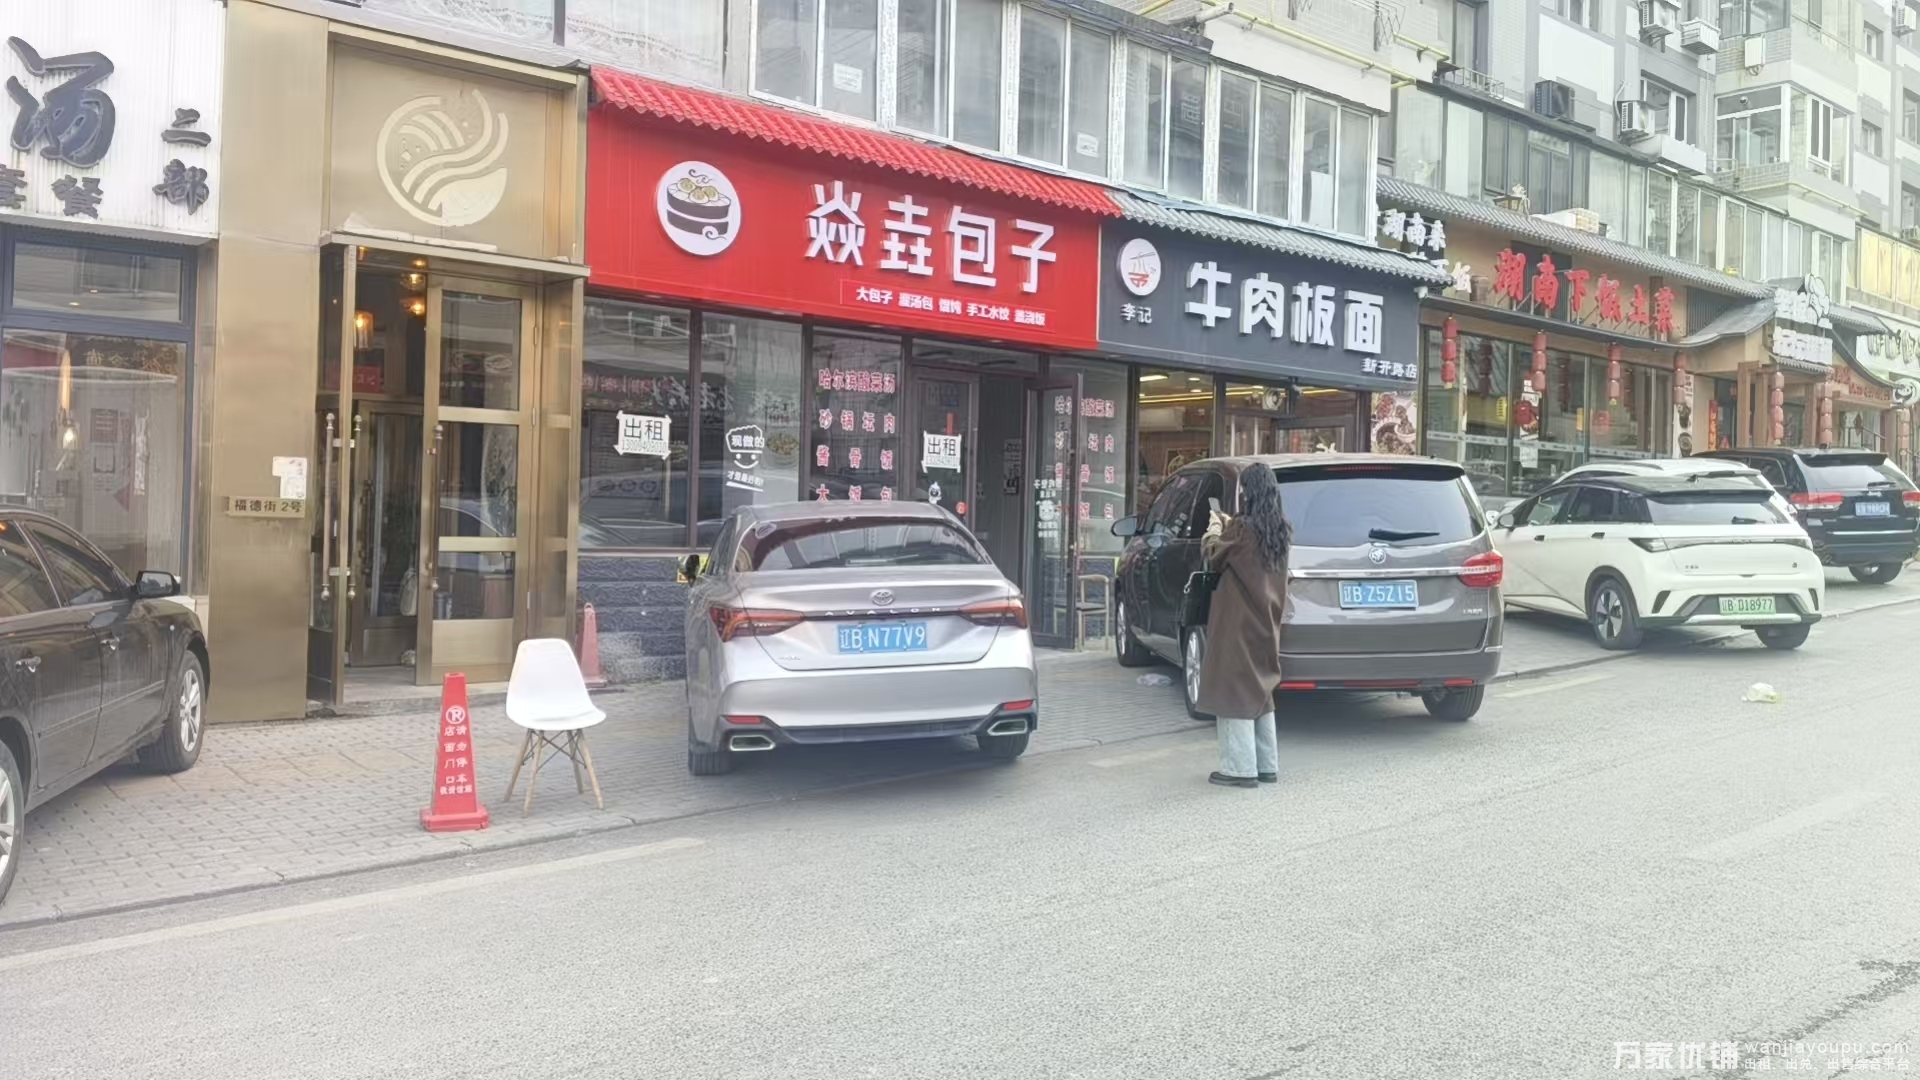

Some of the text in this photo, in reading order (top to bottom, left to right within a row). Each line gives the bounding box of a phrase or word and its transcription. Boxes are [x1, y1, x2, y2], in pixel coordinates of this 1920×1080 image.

[152, 108, 211, 215] 二部
[804, 180, 1057, 294] 焱垚包子
[856, 286, 893, 305] 大包子
[967, 302, 1010, 321] 手工水饺
[1120, 302, 1153, 324] 李记
[1184, 261, 1384, 354] 牛肉板面
[1361, 357, 1418, 379] 新开路店
[818, 367, 896, 394] 哈尔滨酸菜汤
[624, 417, 664, 442] 出租
[818, 408, 896, 434] 砂锅坛肉
[731, 435, 765, 450] 现做的
[927, 436, 957, 457] 出租
[1055, 431, 1114, 453] 砂坛肉
[235, 499, 302, 513] 福德街 2号
[824, 606, 941, 617] AVALON
